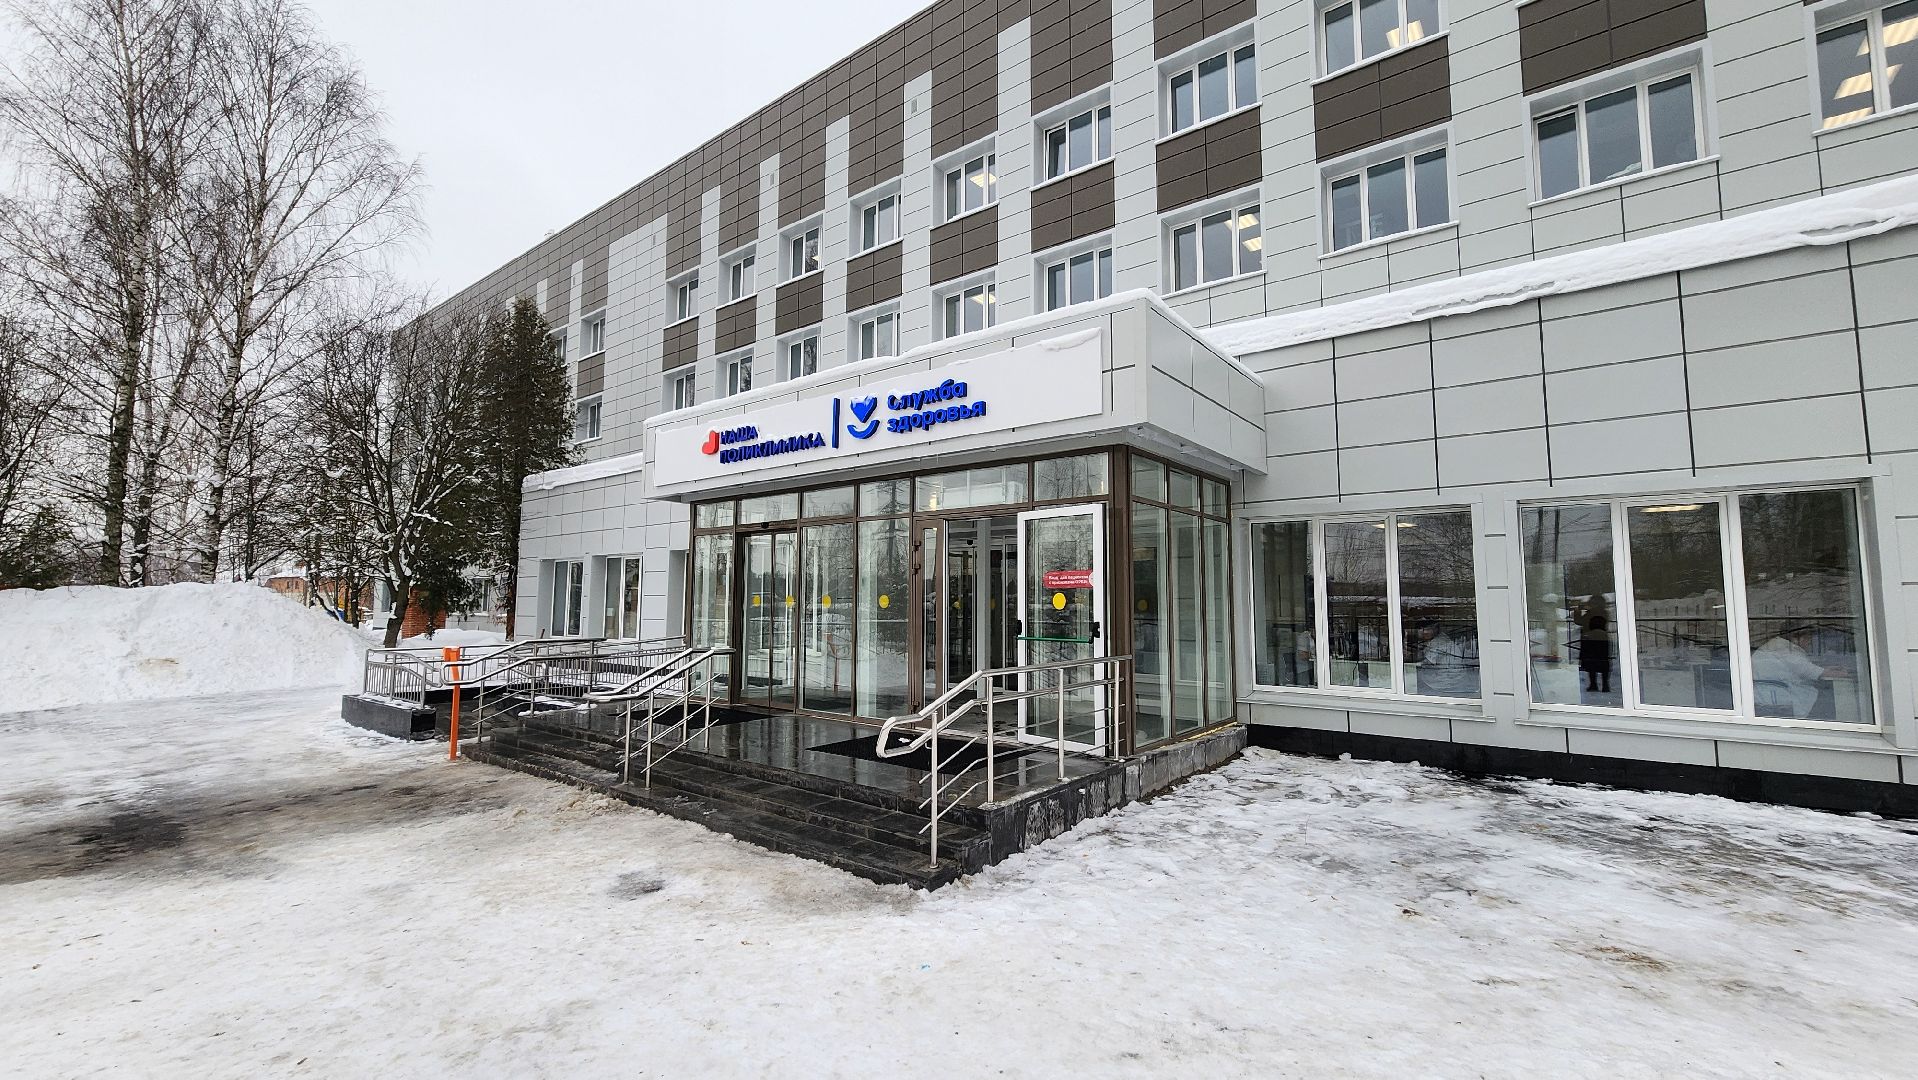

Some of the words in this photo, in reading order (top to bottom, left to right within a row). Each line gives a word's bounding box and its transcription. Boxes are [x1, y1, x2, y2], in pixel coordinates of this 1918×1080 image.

[888, 378, 968, 411] Служба
[887, 401, 987, 433] здоровья
[720, 426, 759, 445] НАША
[720, 432, 826, 464] ПОЛИКЛИНИКА
